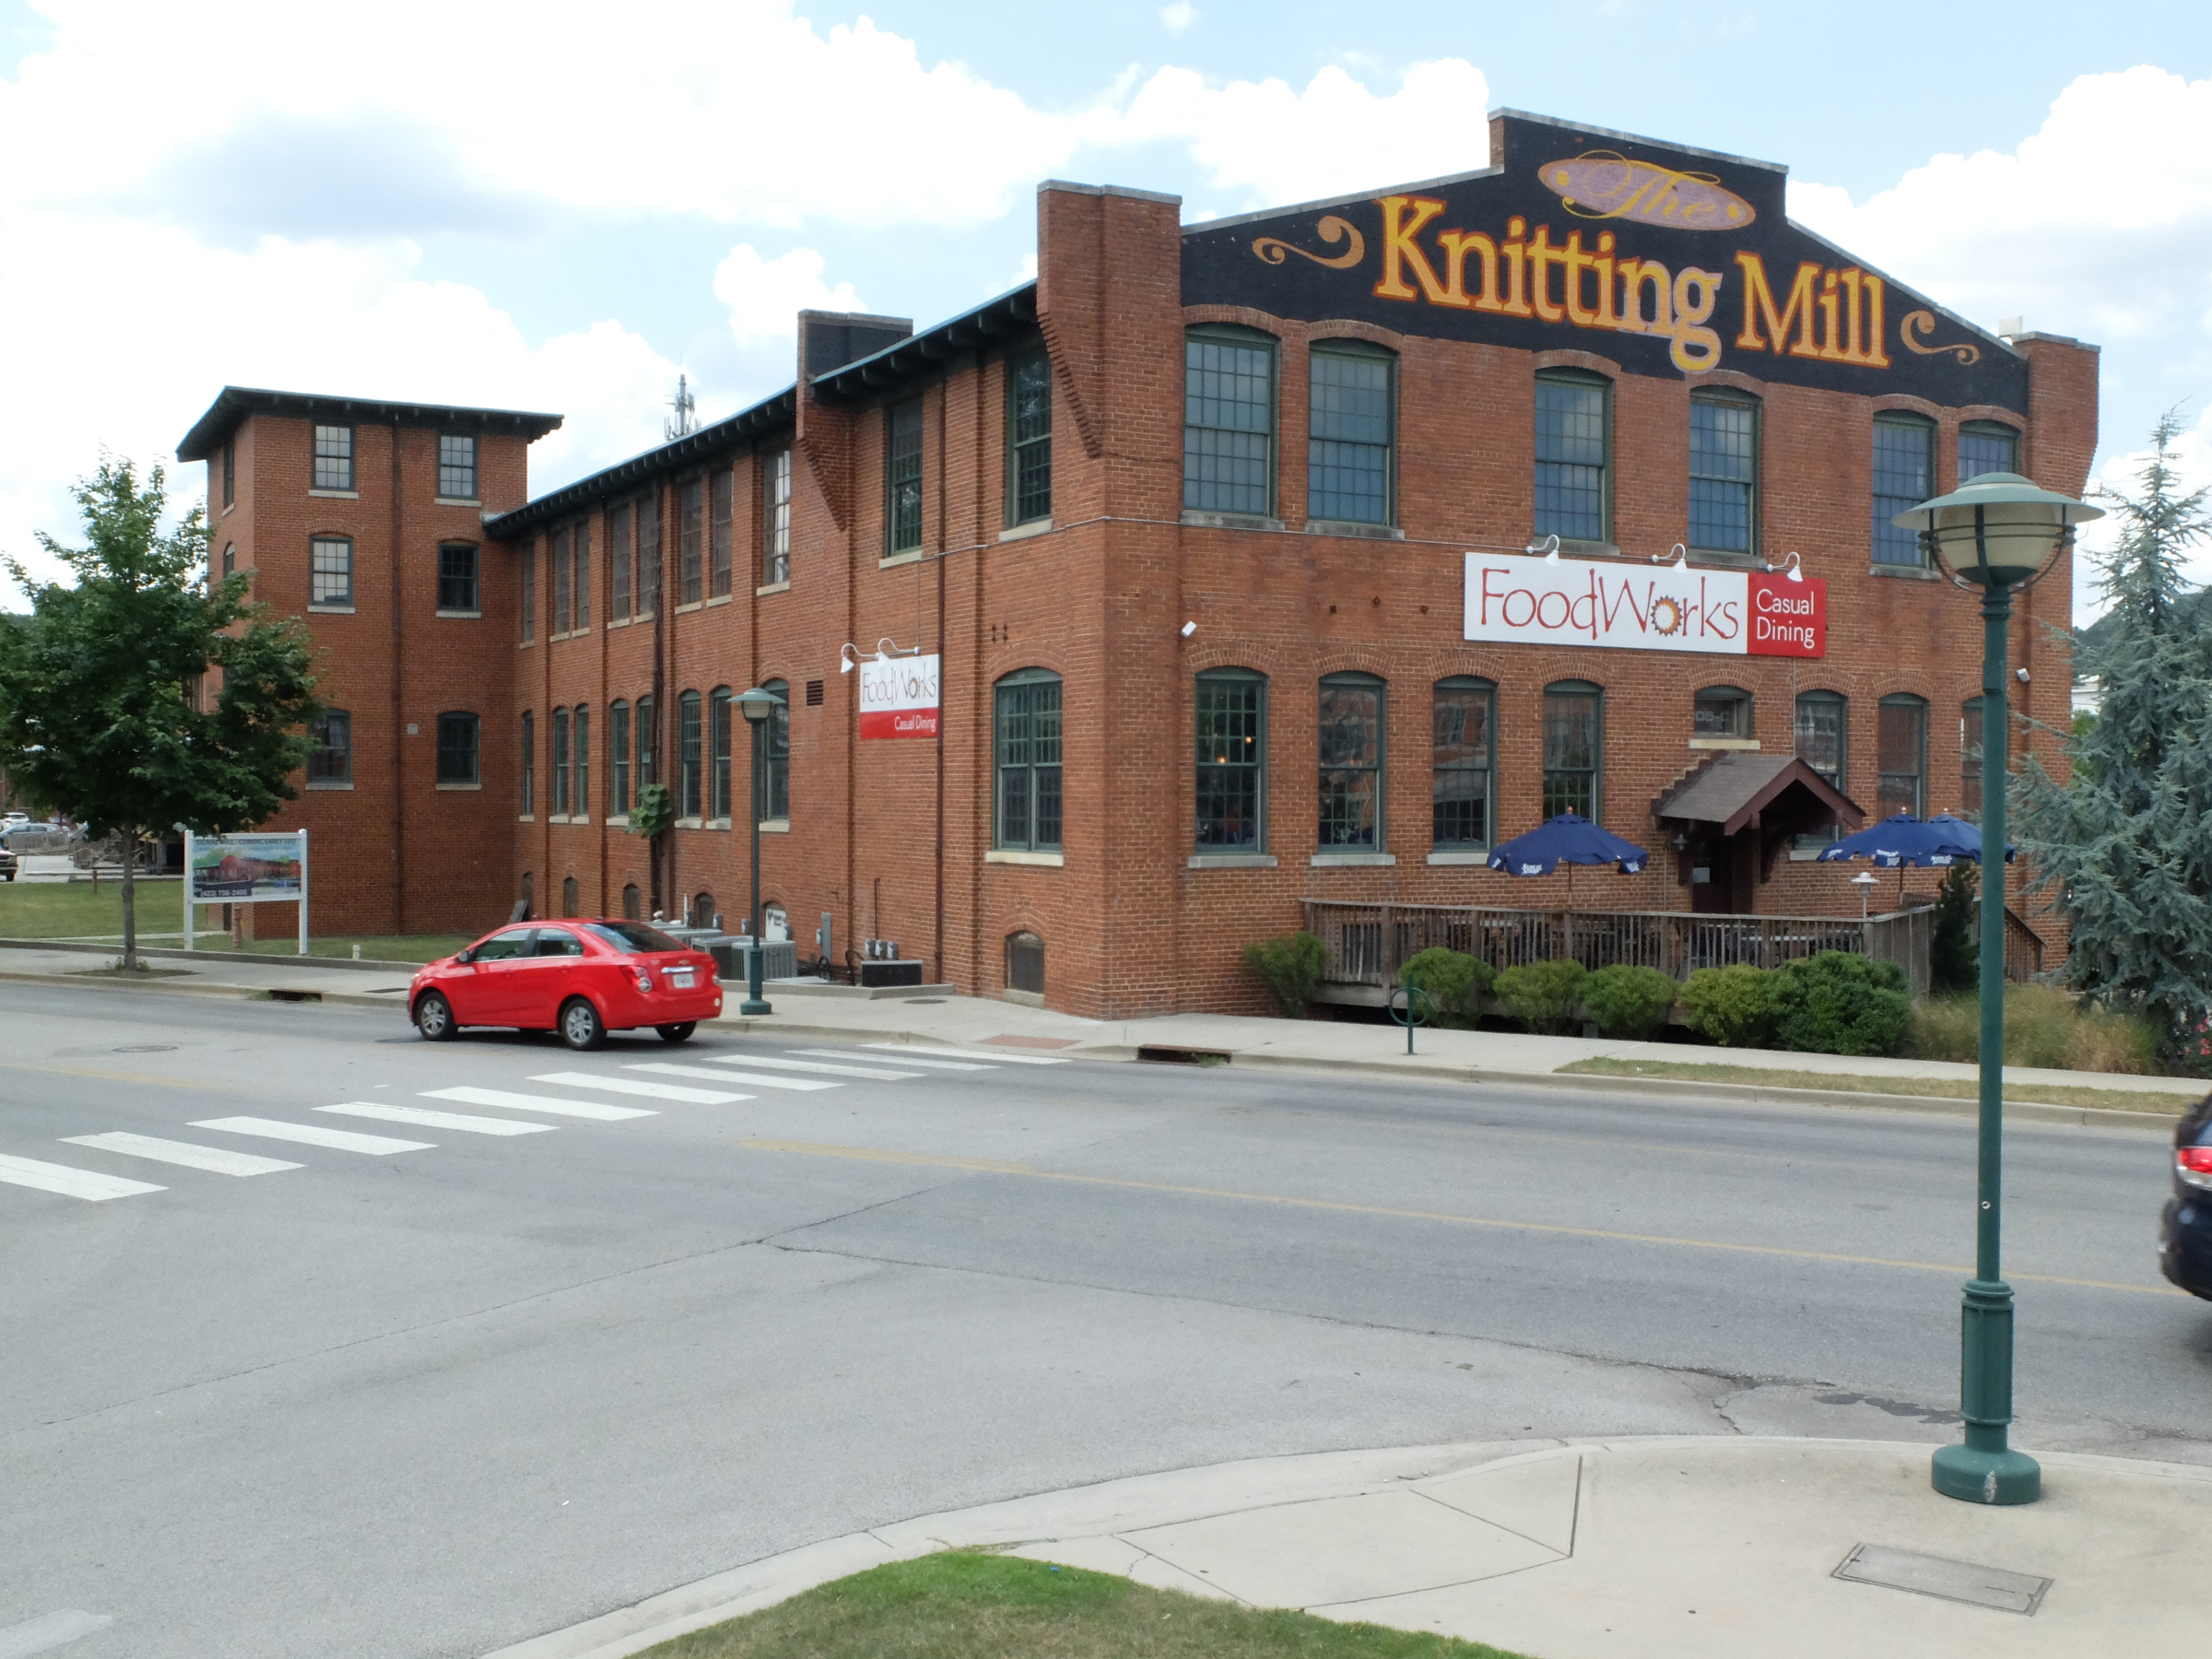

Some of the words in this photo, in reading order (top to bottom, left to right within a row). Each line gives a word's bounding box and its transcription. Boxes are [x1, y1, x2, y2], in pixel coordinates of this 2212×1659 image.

[1562, 149, 1721, 223] The
[1372, 194, 1723, 372] Knitting
[1735, 251, 1891, 369] Mill
[1480, 568, 1739, 641] FoodWorks
[1756, 589, 1815, 617] Casual
[1757, 616, 1815, 649] Dining
[863, 662, 936, 705] FoodWorks
[895, 715, 915, 730] Casual
[915, 714, 935, 733] Dining
